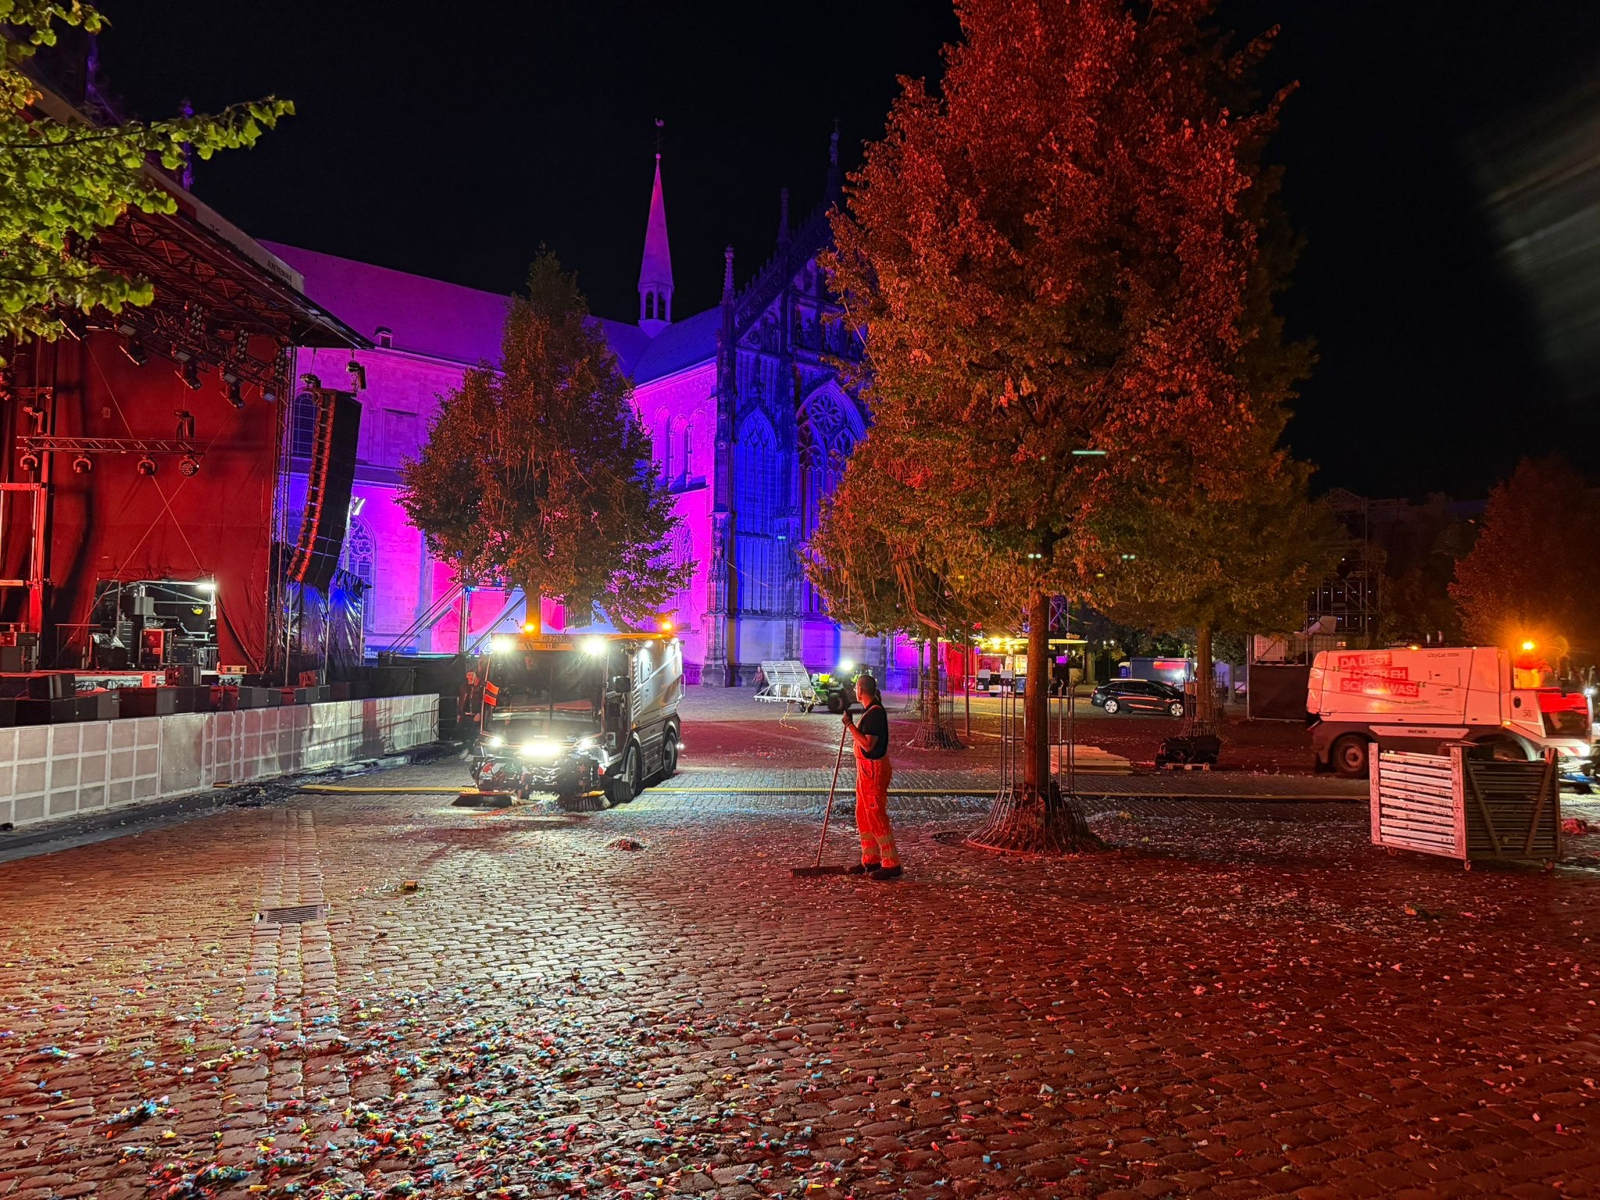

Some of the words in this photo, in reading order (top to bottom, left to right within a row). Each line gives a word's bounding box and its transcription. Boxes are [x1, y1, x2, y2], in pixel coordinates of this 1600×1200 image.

[267, 260, 293, 283] ANTENNE
[1341, 657, 1357, 668] DA
[1359, 654, 1389, 666] LIEGT
[1391, 670, 1406, 679] EH
